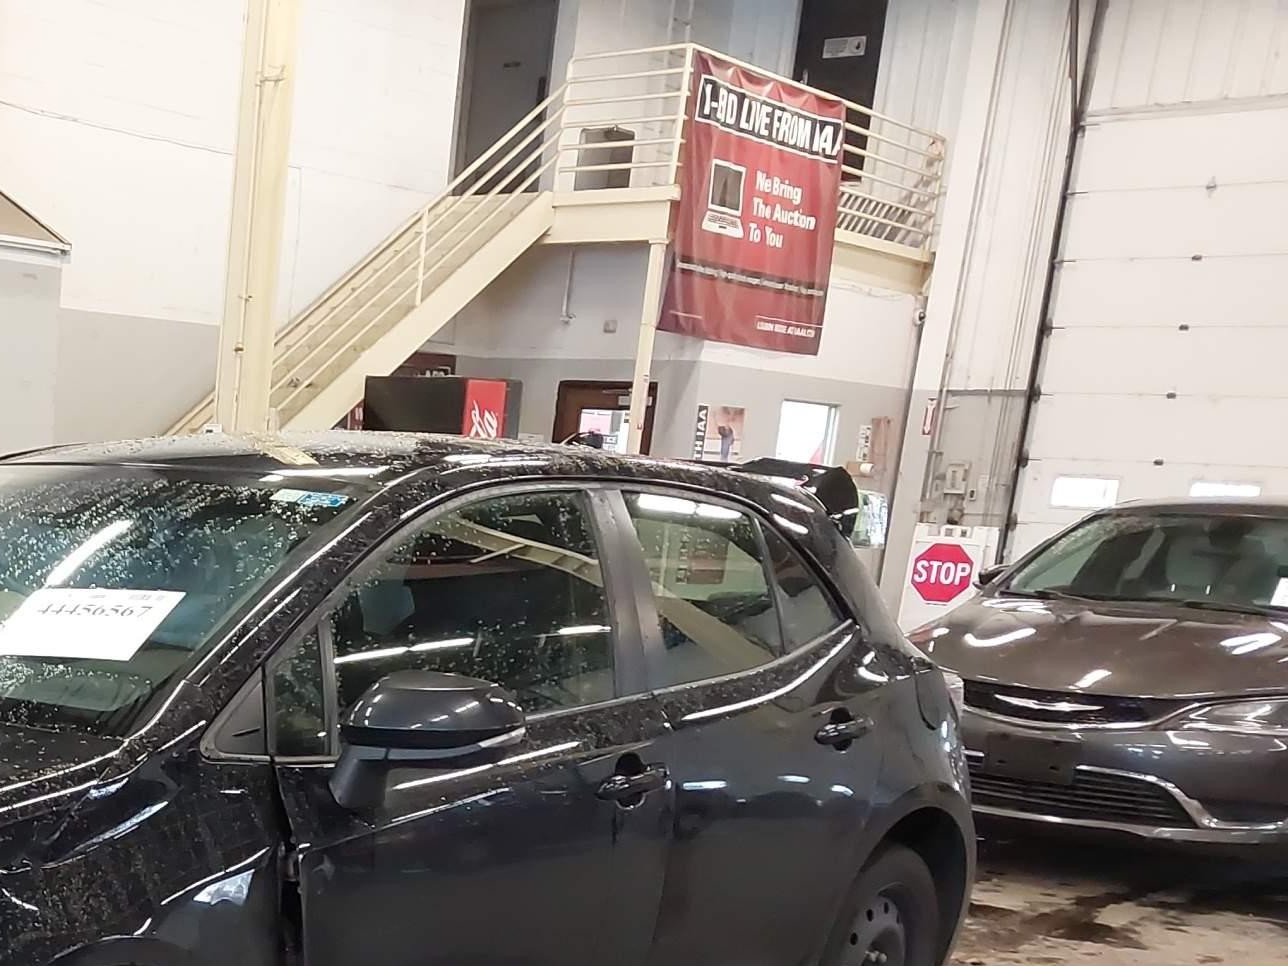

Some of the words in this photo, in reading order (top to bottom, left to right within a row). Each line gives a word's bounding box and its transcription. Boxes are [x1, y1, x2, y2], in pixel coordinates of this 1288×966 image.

[740, 98, 773, 136] LIVE
[772, 108, 812, 150] FROM
[772, 176, 802, 205] Bring
[753, 197, 772, 219] The
[772, 203, 816, 230] Auction
[749, 222, 761, 243] To
[765, 225, 783, 248] You
[696, 409, 707, 436] IAA
[913, 559, 971, 586] STOP
